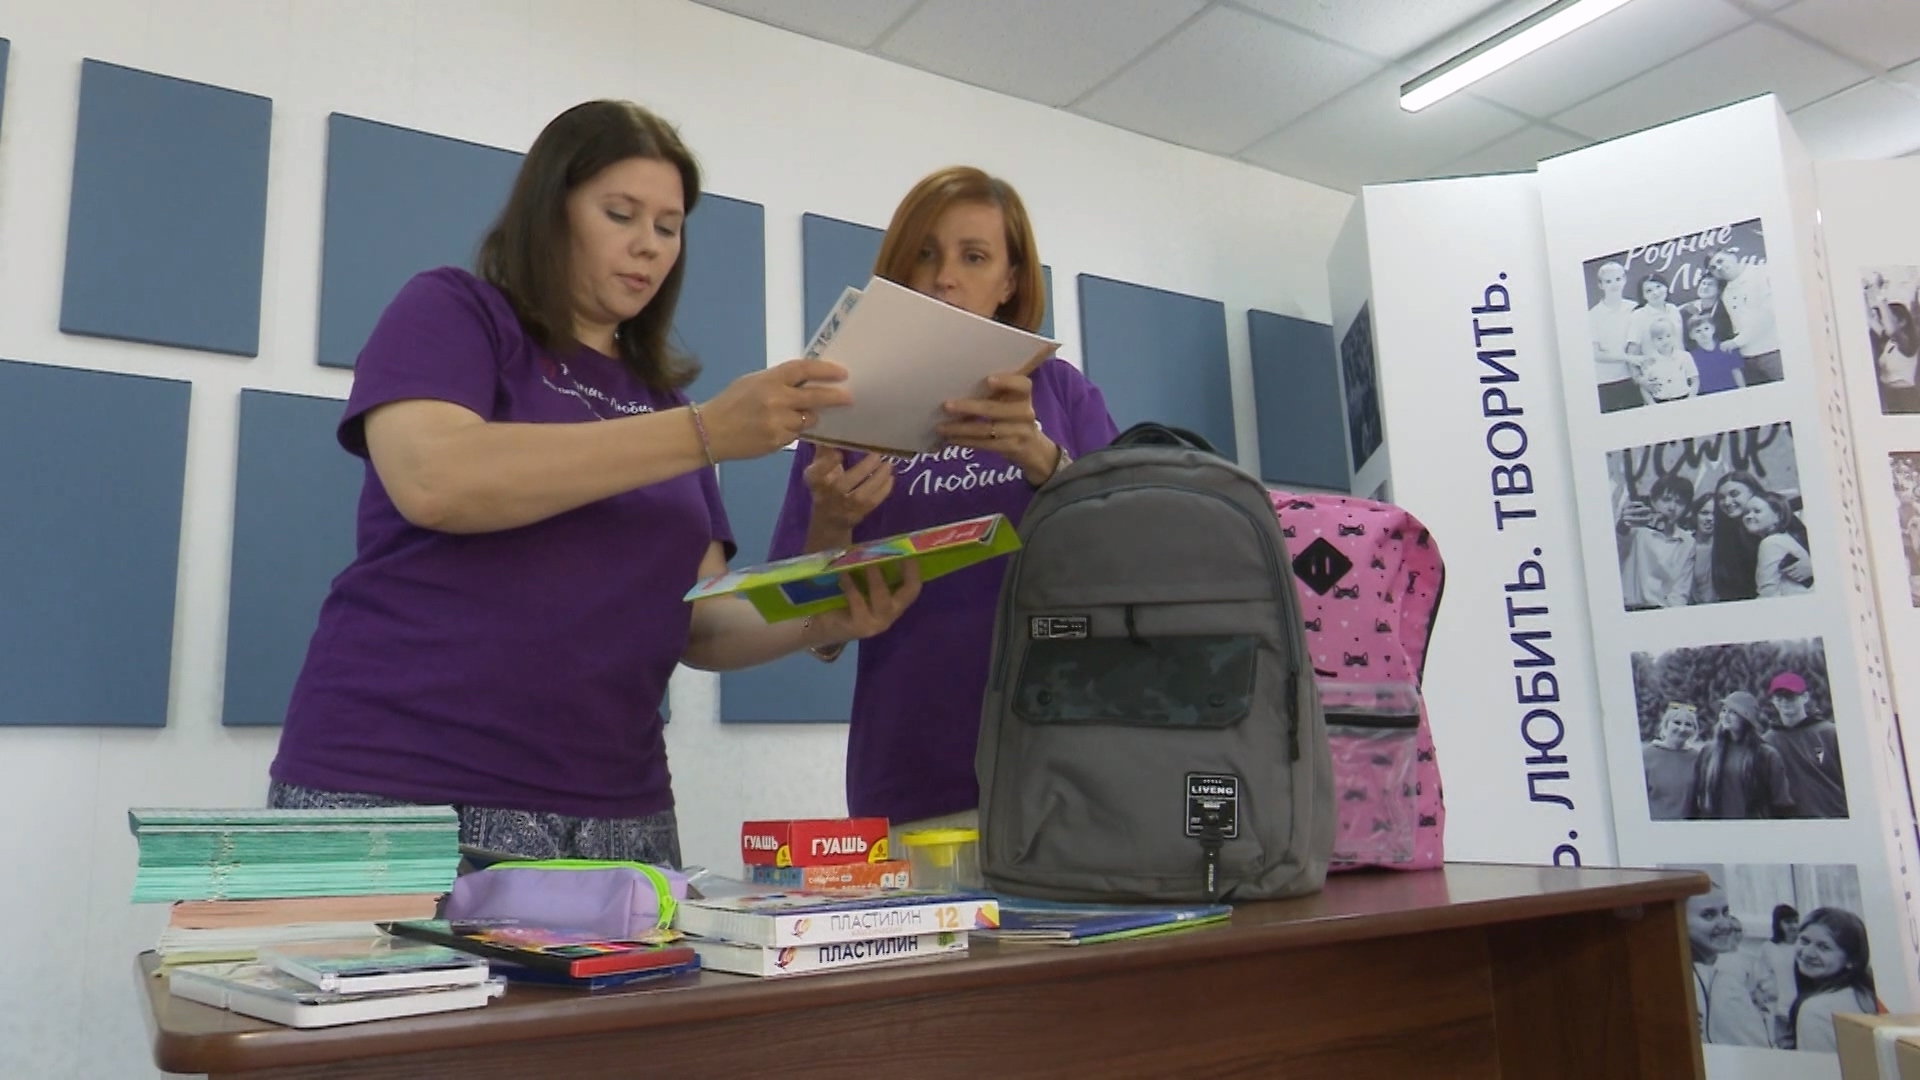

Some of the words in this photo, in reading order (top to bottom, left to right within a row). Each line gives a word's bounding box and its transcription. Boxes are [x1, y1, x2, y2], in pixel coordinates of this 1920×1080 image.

[1471, 272, 1537, 531] ТВОРИТЬ.
[1504, 547, 1575, 810] ЛЮБИТЬ.
[743, 835, 779, 850] ГУАШЬ
[811, 837, 868, 856] ГУАШЬ
[831, 910, 922, 931] ПЛАСТИЛИН
[934, 907, 960, 929] 12
[818, 936, 918, 963] ПЛАСТИЛИН
